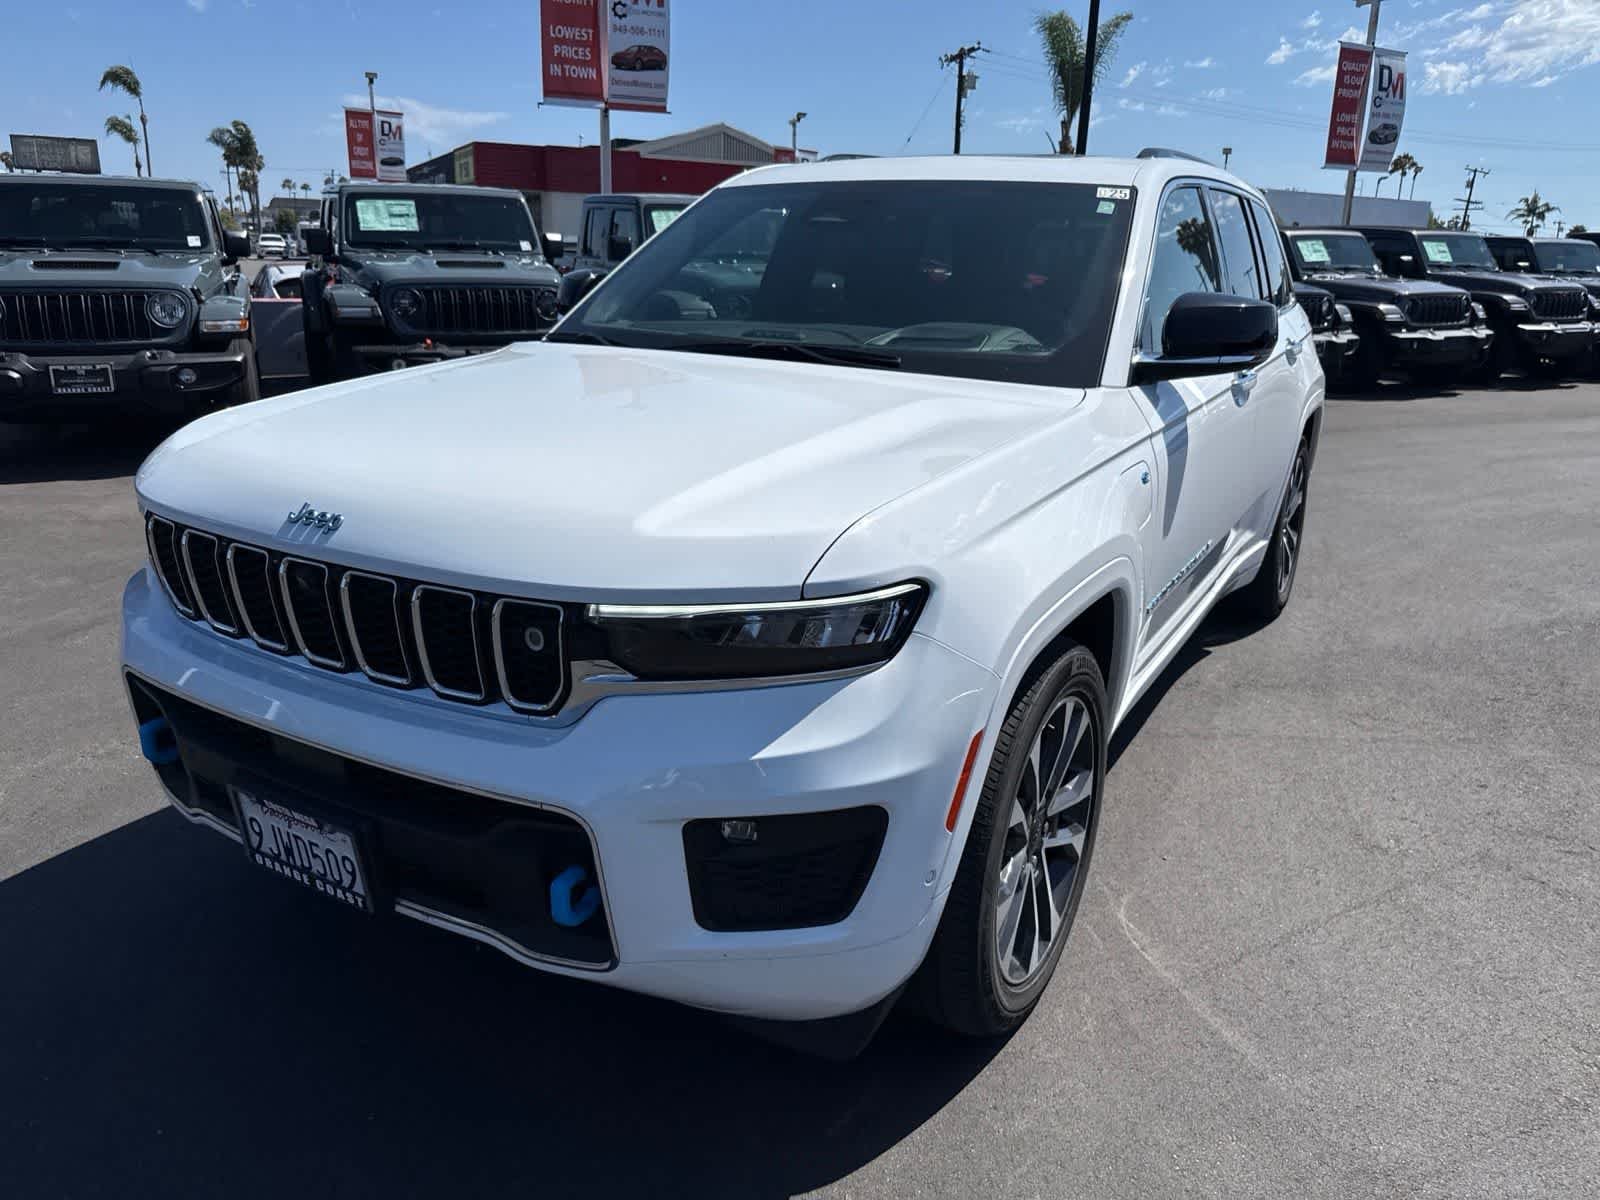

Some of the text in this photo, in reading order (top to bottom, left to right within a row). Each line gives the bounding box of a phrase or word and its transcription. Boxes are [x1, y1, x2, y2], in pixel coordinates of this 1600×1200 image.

[550, 25, 594, 41] LOWEST
[553, 45, 591, 60] PRICES
[550, 64, 597, 80] IN TOWN
[1342, 62, 1368, 73] QUALITY
[287, 502, 344, 535] Jeep
[249, 816, 357, 891] 9JWD509
